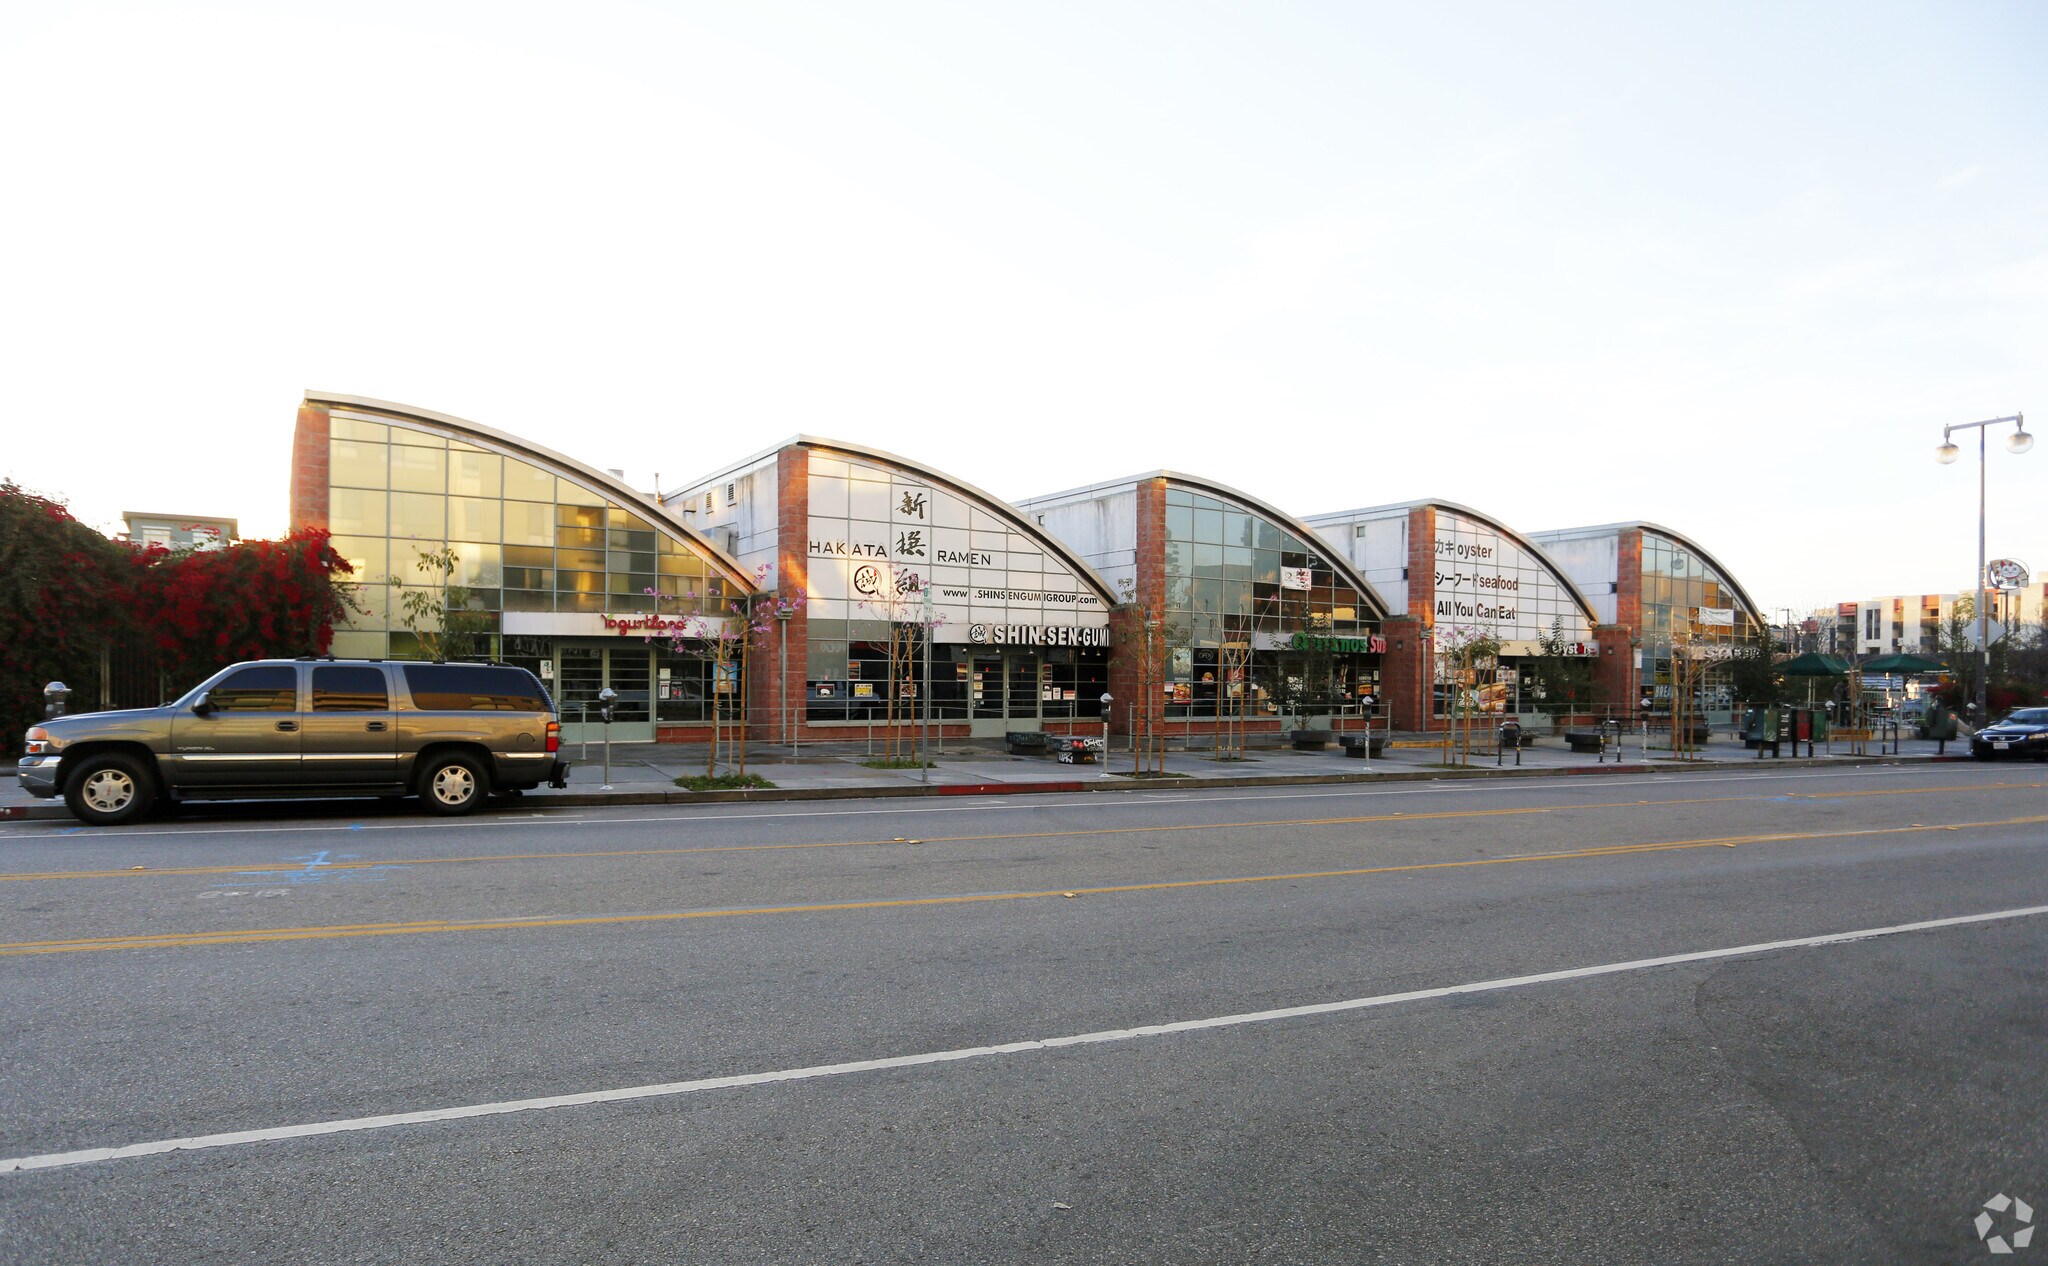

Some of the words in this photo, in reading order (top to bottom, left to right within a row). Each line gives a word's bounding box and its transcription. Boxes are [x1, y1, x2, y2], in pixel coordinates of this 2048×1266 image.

[809, 541, 888, 558] HAKATA
[937, 550, 991, 565] RAMEN
[1457, 544, 1493, 559] oyster
[1480, 575, 1519, 591] seafood
[1437, 600, 1452, 616] All
[1454, 602, 1473, 617] You
[1477, 603, 1496, 619] Can
[1499, 605, 1515, 620] Eat
[993, 625, 1110, 647] SHIN-SEN-GUMI
